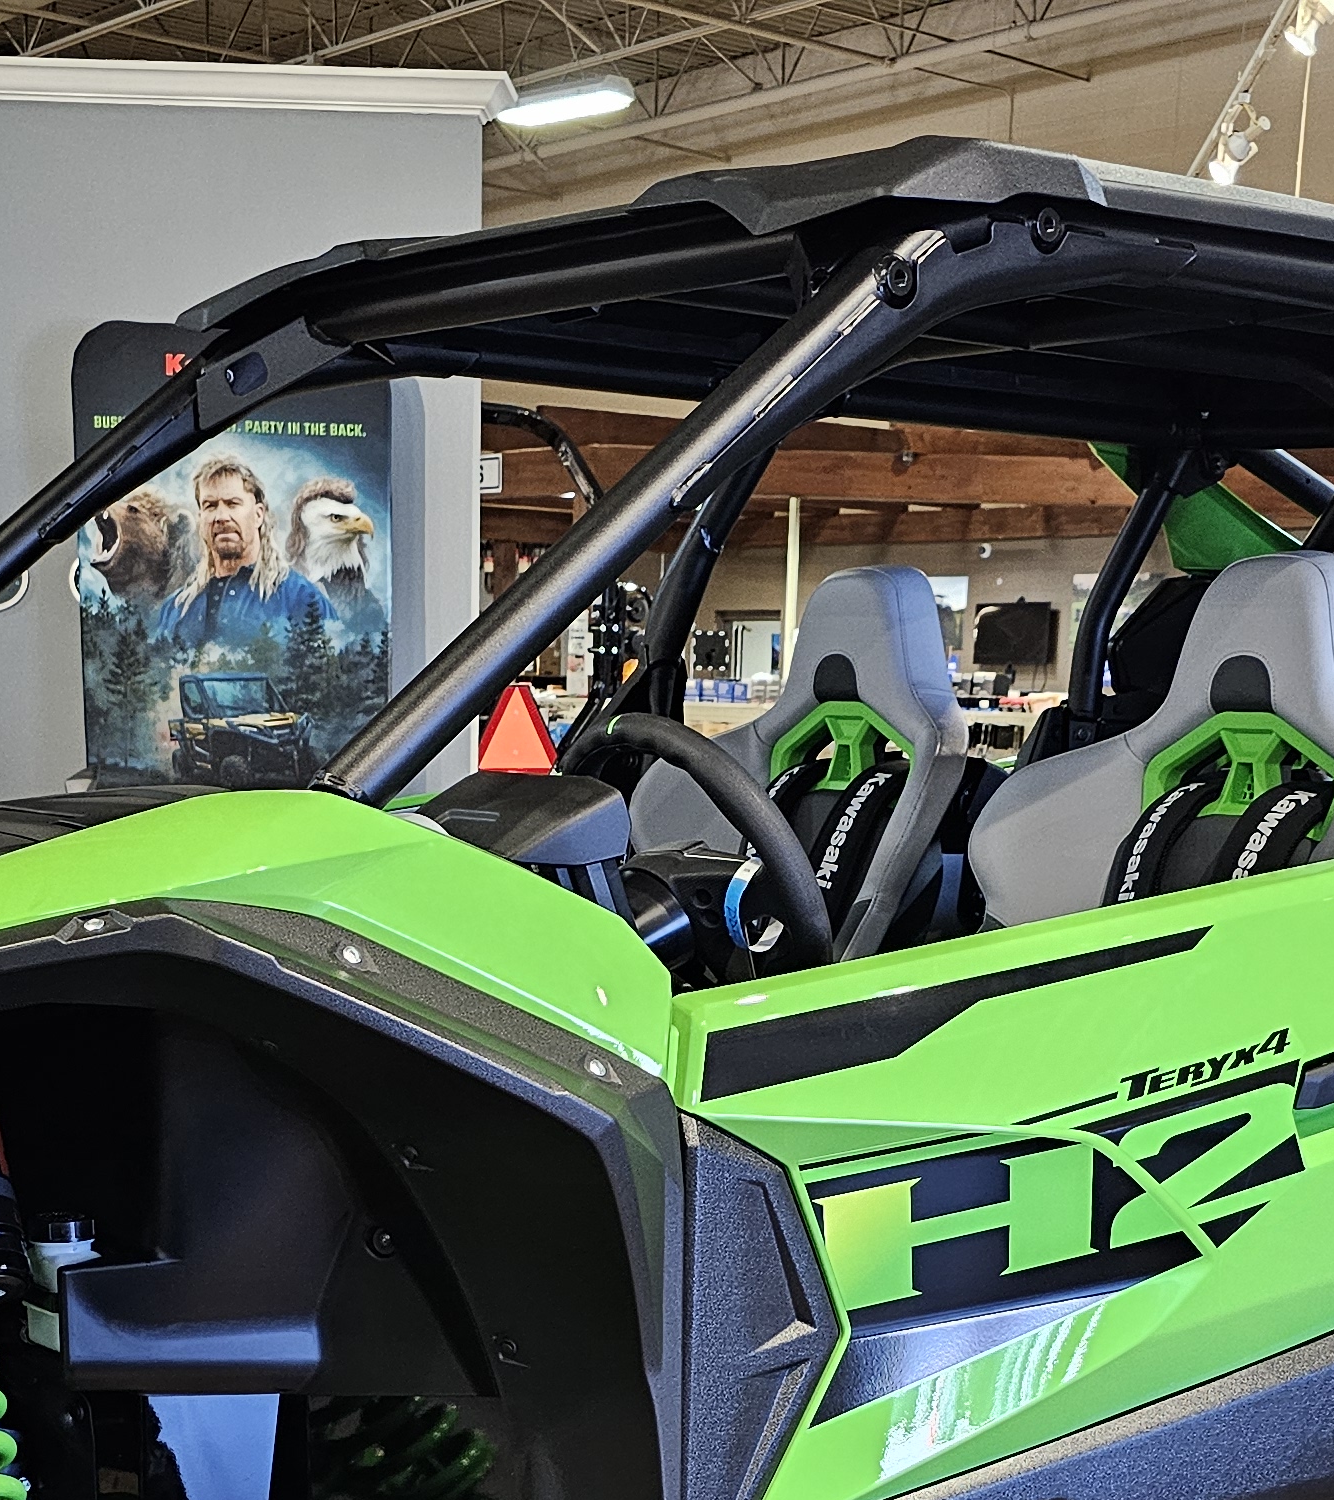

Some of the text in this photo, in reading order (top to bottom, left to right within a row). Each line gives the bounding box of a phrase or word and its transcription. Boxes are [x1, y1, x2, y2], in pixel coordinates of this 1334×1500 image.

[94, 415, 126, 428] BUS
[244, 420, 284, 434] PARTY
[288, 421, 300, 435] IN
[303, 422, 326, 436] THE
[330, 423, 366, 437] BACK.
[815, 772, 893, 889] Kawasaki
[1117, 782, 1206, 901] Kawasaki
[1233, 790, 1317, 880] Kawasa
[812, 1083, 1303, 1310] H2
